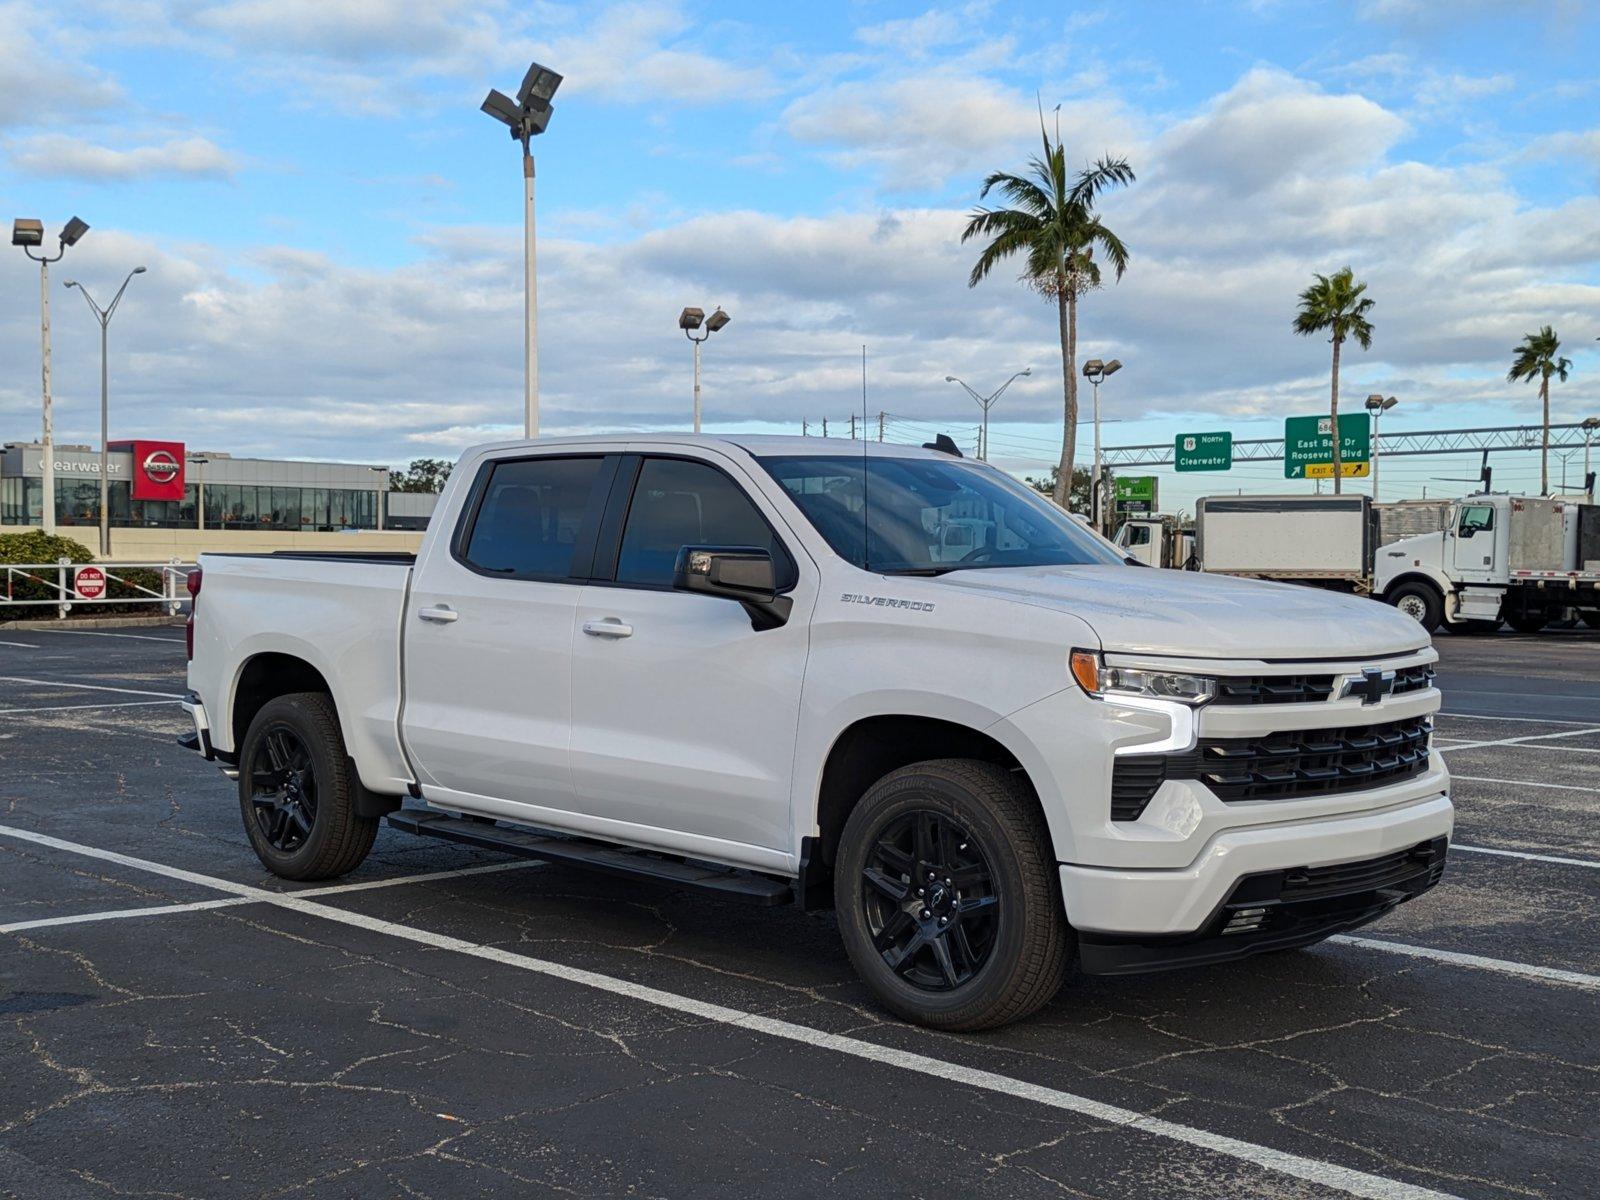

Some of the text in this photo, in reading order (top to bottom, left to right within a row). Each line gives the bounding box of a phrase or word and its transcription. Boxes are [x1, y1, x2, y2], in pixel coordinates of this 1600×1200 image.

[1186, 440, 1194, 449] 19
[1297, 440, 1318, 448] East
[1344, 438, 1356, 446] Dr
[1291, 449, 1362, 460] Roosevel Blvd
[1180, 457, 1226, 466] Clearwater
[840, 593, 936, 612] SILVERADO
